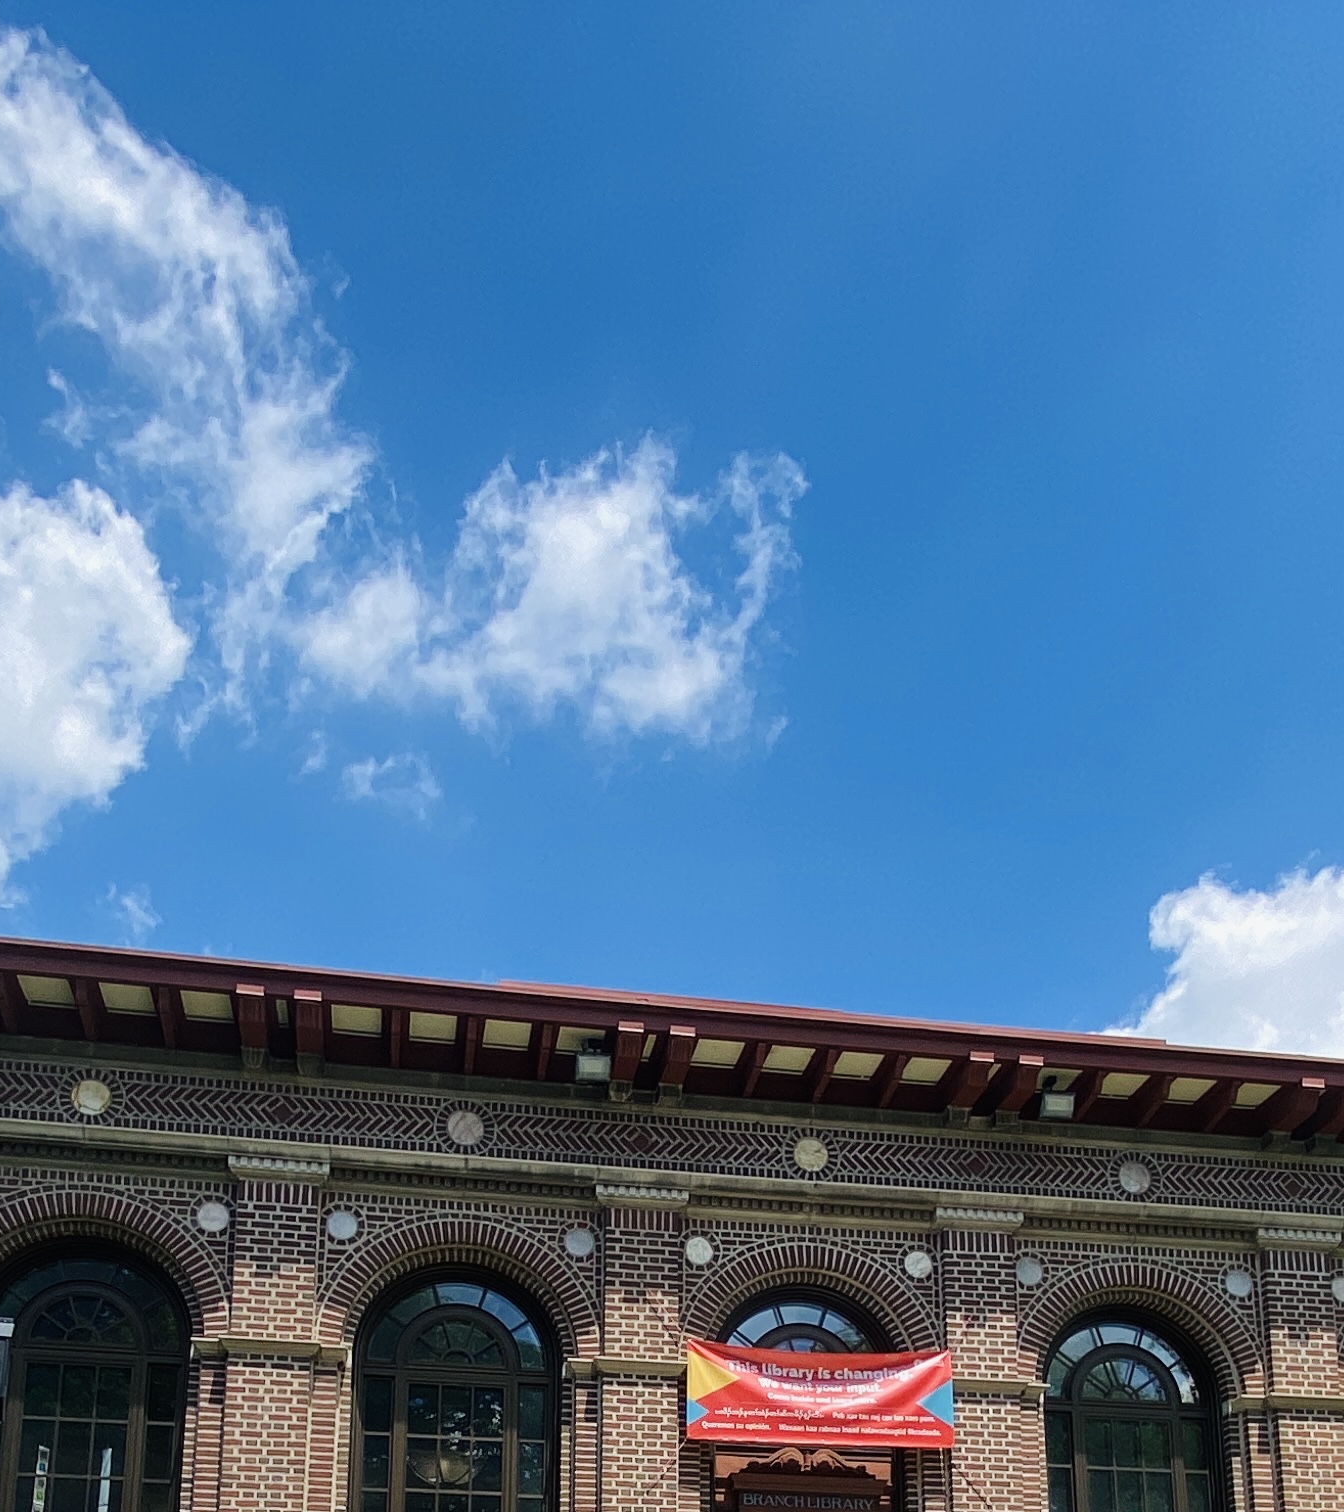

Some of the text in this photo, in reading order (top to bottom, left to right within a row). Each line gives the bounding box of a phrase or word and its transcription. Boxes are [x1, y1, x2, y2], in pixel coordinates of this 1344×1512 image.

[728, 1359, 914, 1382] This library is changing.
[757, 1377, 884, 1395] We want your input.
[742, 1492, 874, 1511] BRANCH LIBRARY
